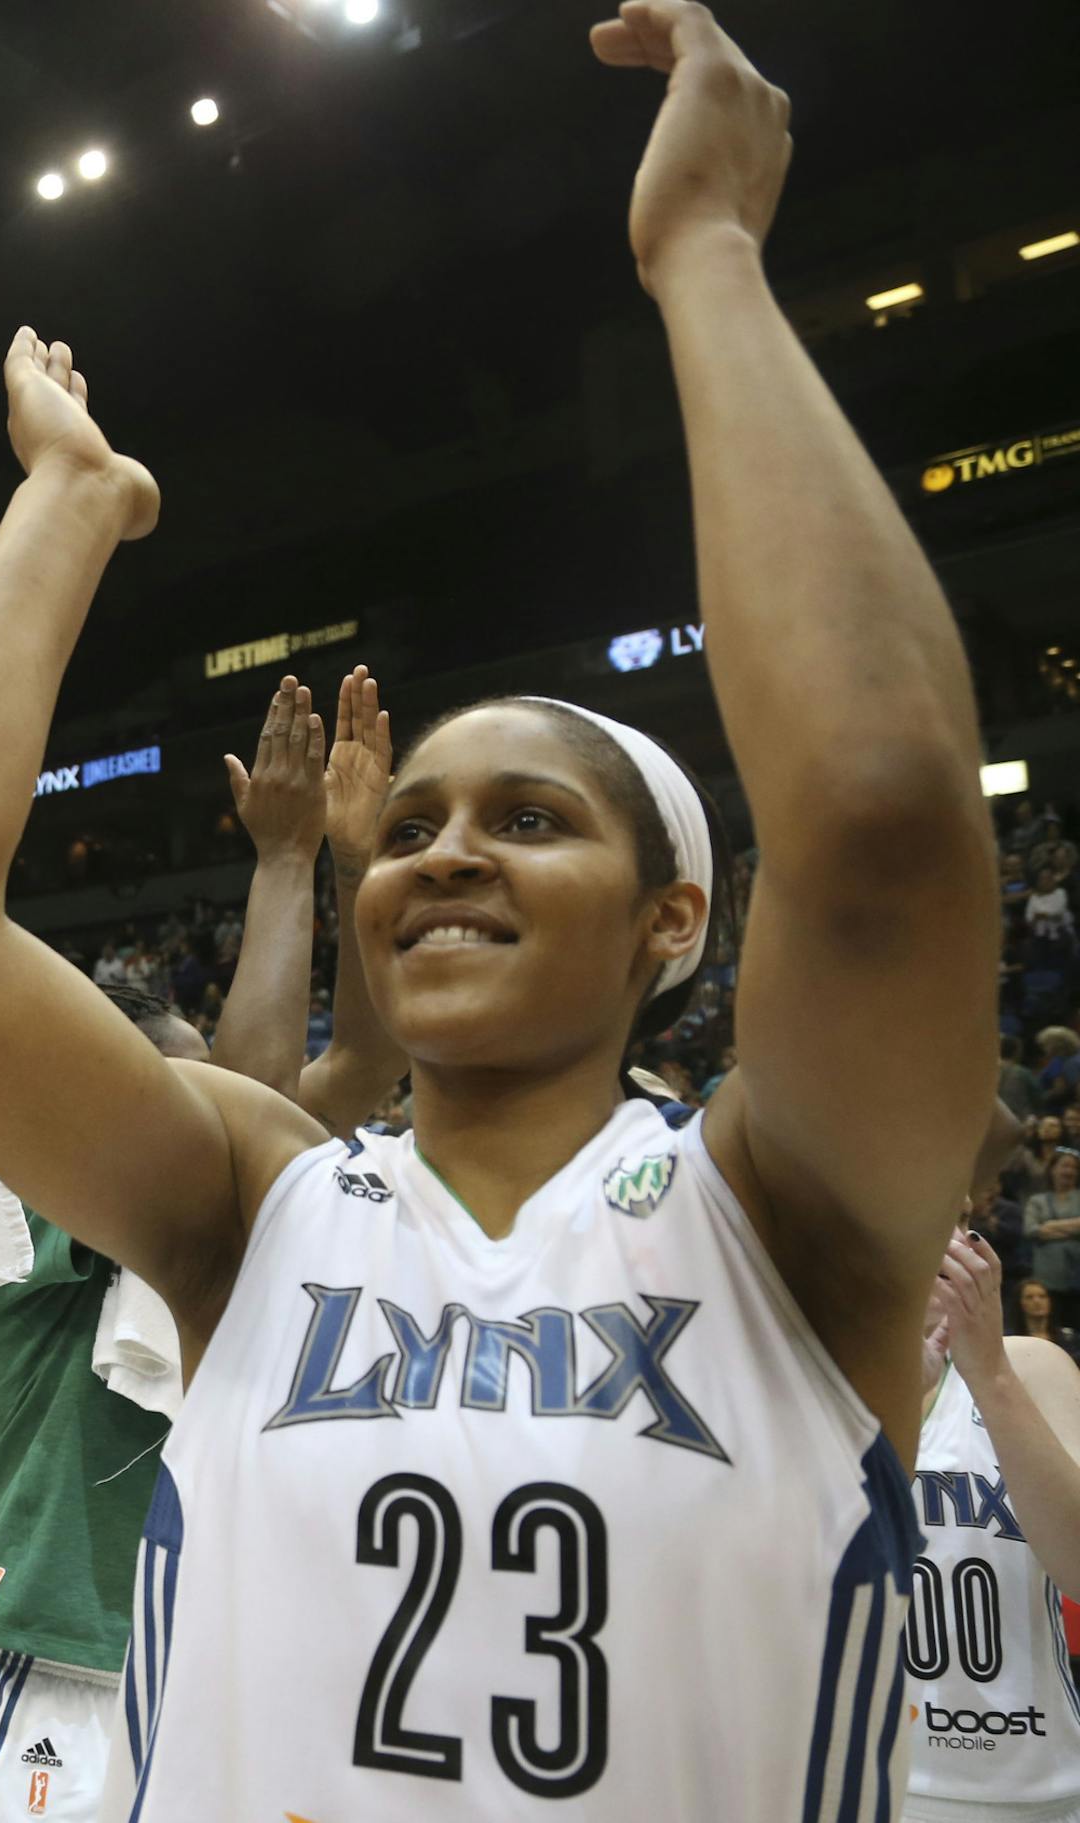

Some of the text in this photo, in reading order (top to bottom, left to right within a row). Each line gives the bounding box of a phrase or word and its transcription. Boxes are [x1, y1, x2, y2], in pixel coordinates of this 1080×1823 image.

[953, 440, 1034, 482] TMG
[32, 764, 80, 797] YNX
[261, 1283, 734, 1467] LYNX
[913, 1466, 1028, 1543] NX
[352, 1472, 608, 1799] 23
[904, 1556, 1003, 1683] 00
[924, 1702, 1046, 1737] boost
[21, 1754, 63, 1768] adidas
[928, 1735, 997, 1751] mobile
